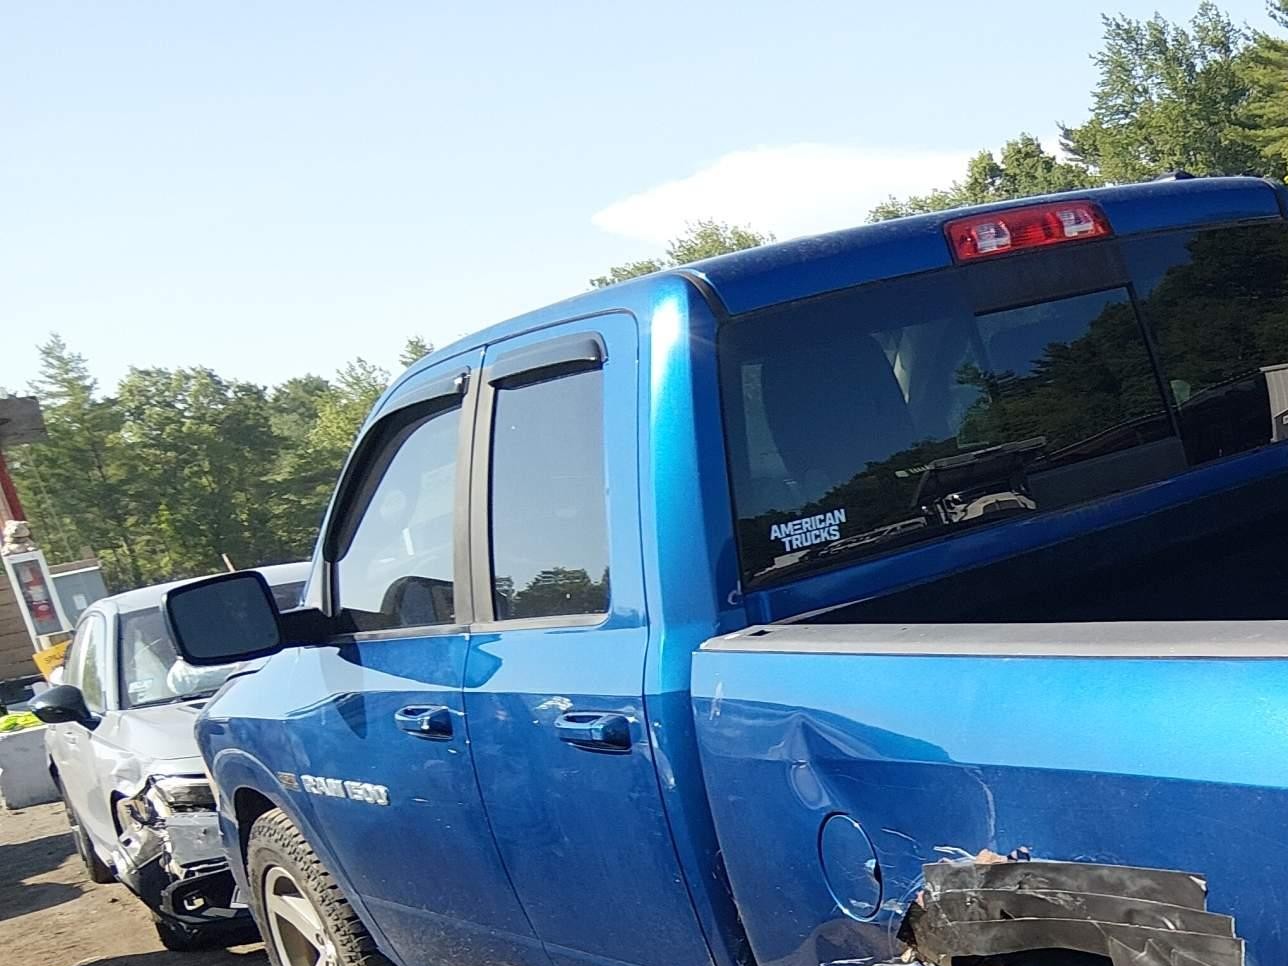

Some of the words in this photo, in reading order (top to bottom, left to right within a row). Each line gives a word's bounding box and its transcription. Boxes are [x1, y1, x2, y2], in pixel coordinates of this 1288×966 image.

[770, 508, 847, 541] AMERICAN
[781, 525, 841, 552] TRUCKS
[300, 774, 345, 798] RAM
